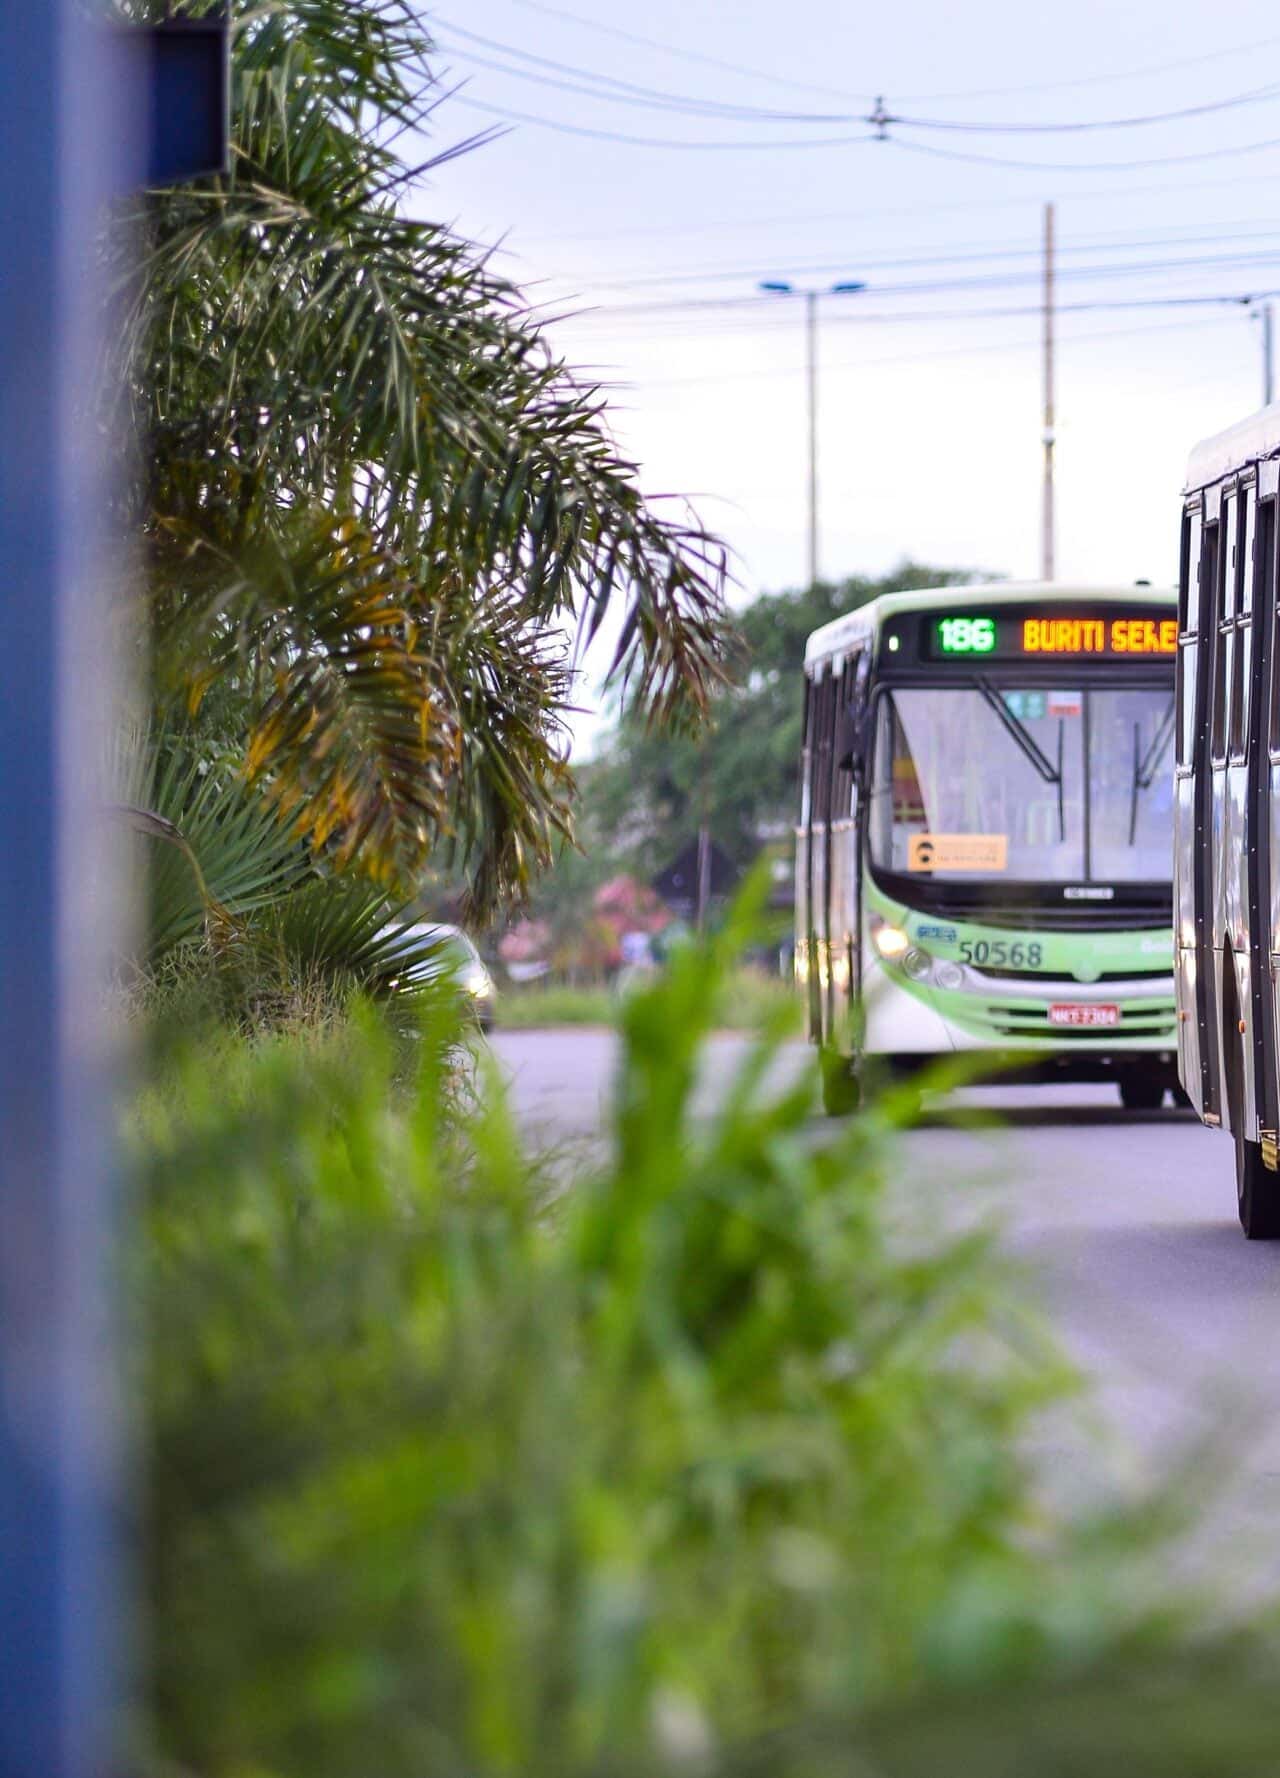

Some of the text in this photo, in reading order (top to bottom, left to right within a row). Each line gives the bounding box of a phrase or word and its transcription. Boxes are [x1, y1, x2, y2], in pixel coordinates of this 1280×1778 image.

[939, 618, 994, 652] 186
[1024, 620, 1104, 652] BURITI
[959, 941, 1042, 968] 50568
